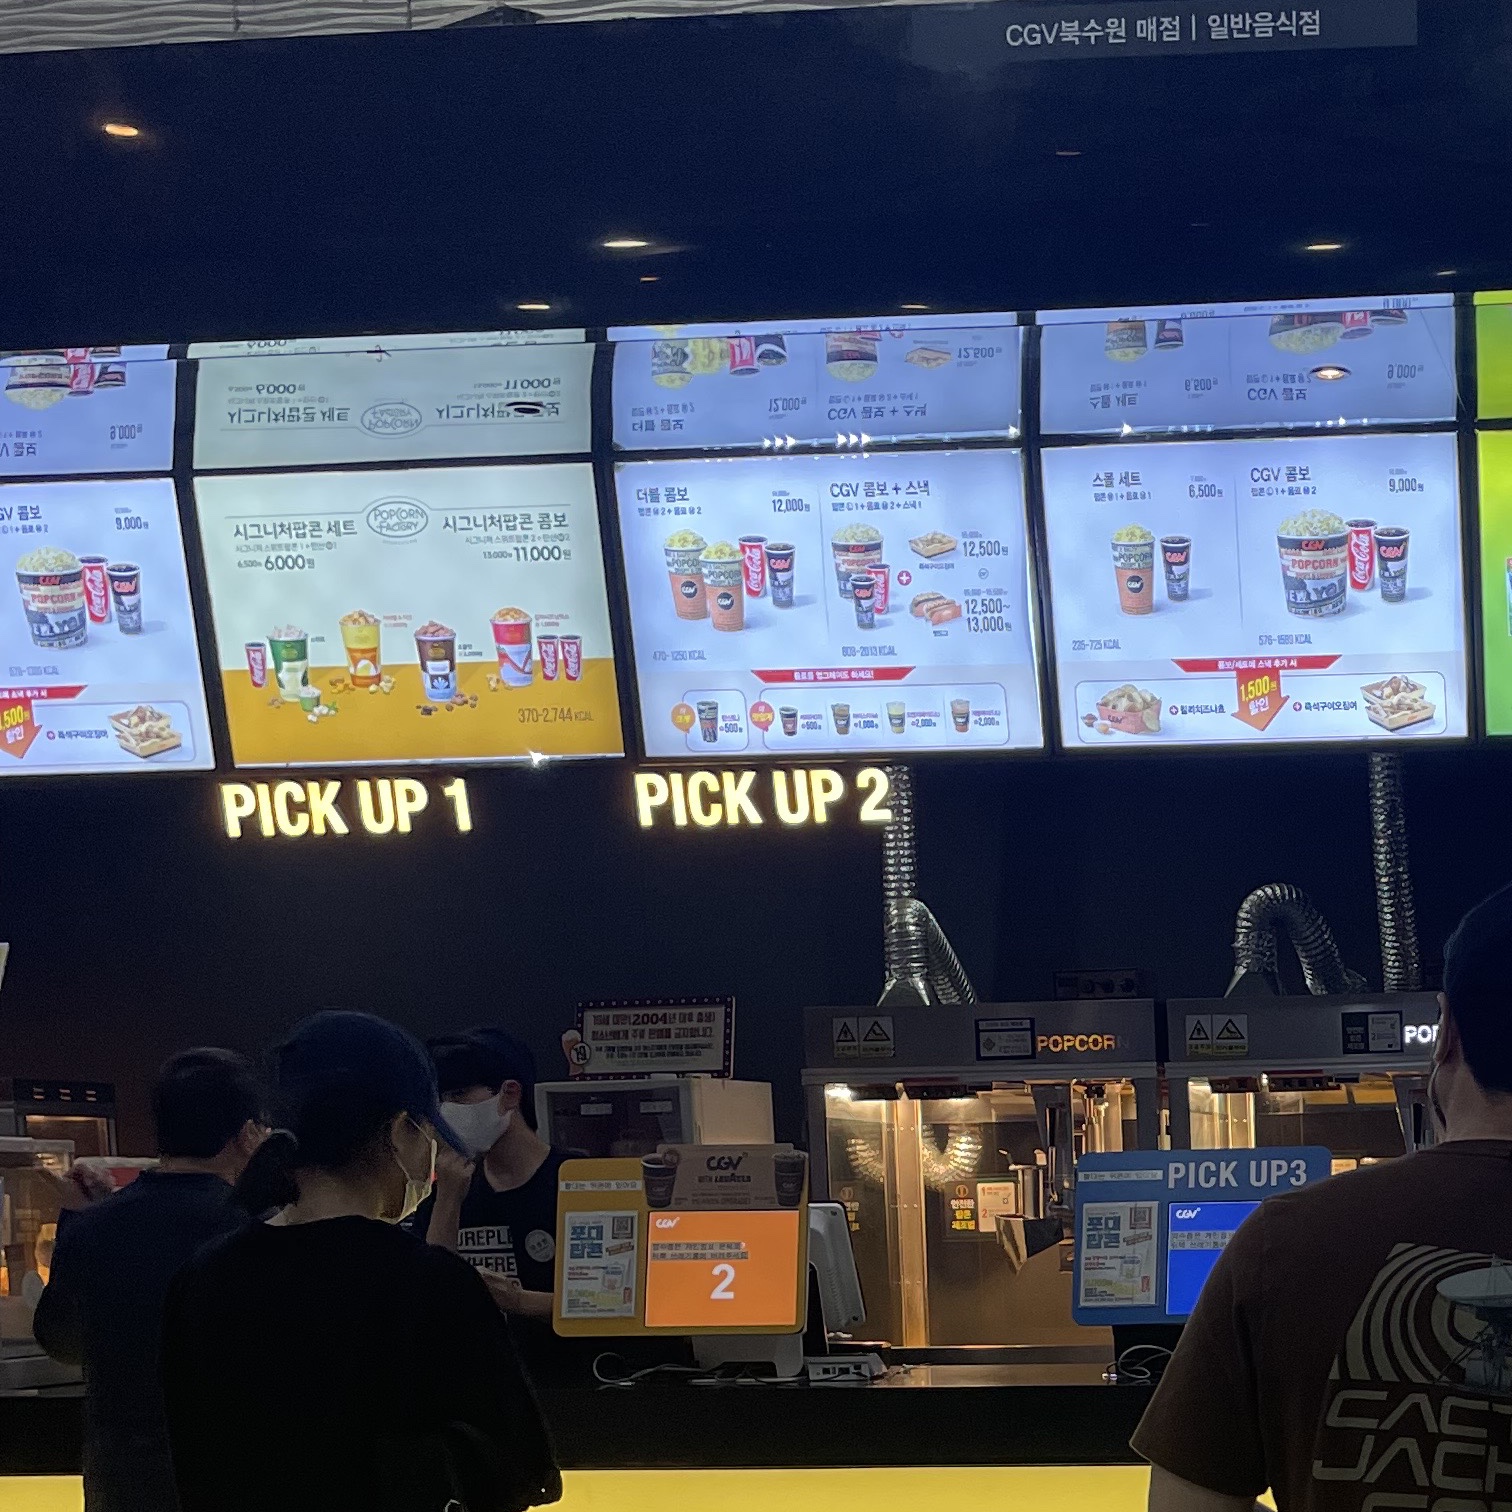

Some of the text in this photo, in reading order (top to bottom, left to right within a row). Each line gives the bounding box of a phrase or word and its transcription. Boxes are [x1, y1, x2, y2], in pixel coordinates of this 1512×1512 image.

[1005, 10, 1321, 47] CGV북수원 매점 일반음식점
[1118, 471, 1143, 488] 세트
[1250, 466, 1312, 483] CGV 콤보
[664, 486, 689, 503] 콤보
[829, 482, 860, 499] CGV
[863, 481, 889, 498] 콤보
[904, 479, 931, 497] 스낵
[233, 519, 358, 540] 시그니처팝콘 세트
[442, 511, 570, 532] 시그니처팝콘 콤보
[220, 777, 474, 838] PICK UP 1
[634, 767, 893, 828] PICK UP 2
[706, 1155, 742, 1172] CGV
[1167, 1158, 1308, 1189] PICK UP3
[1175, 1207, 1201, 1220] CGV
[710, 1262, 736, 1300] 2
